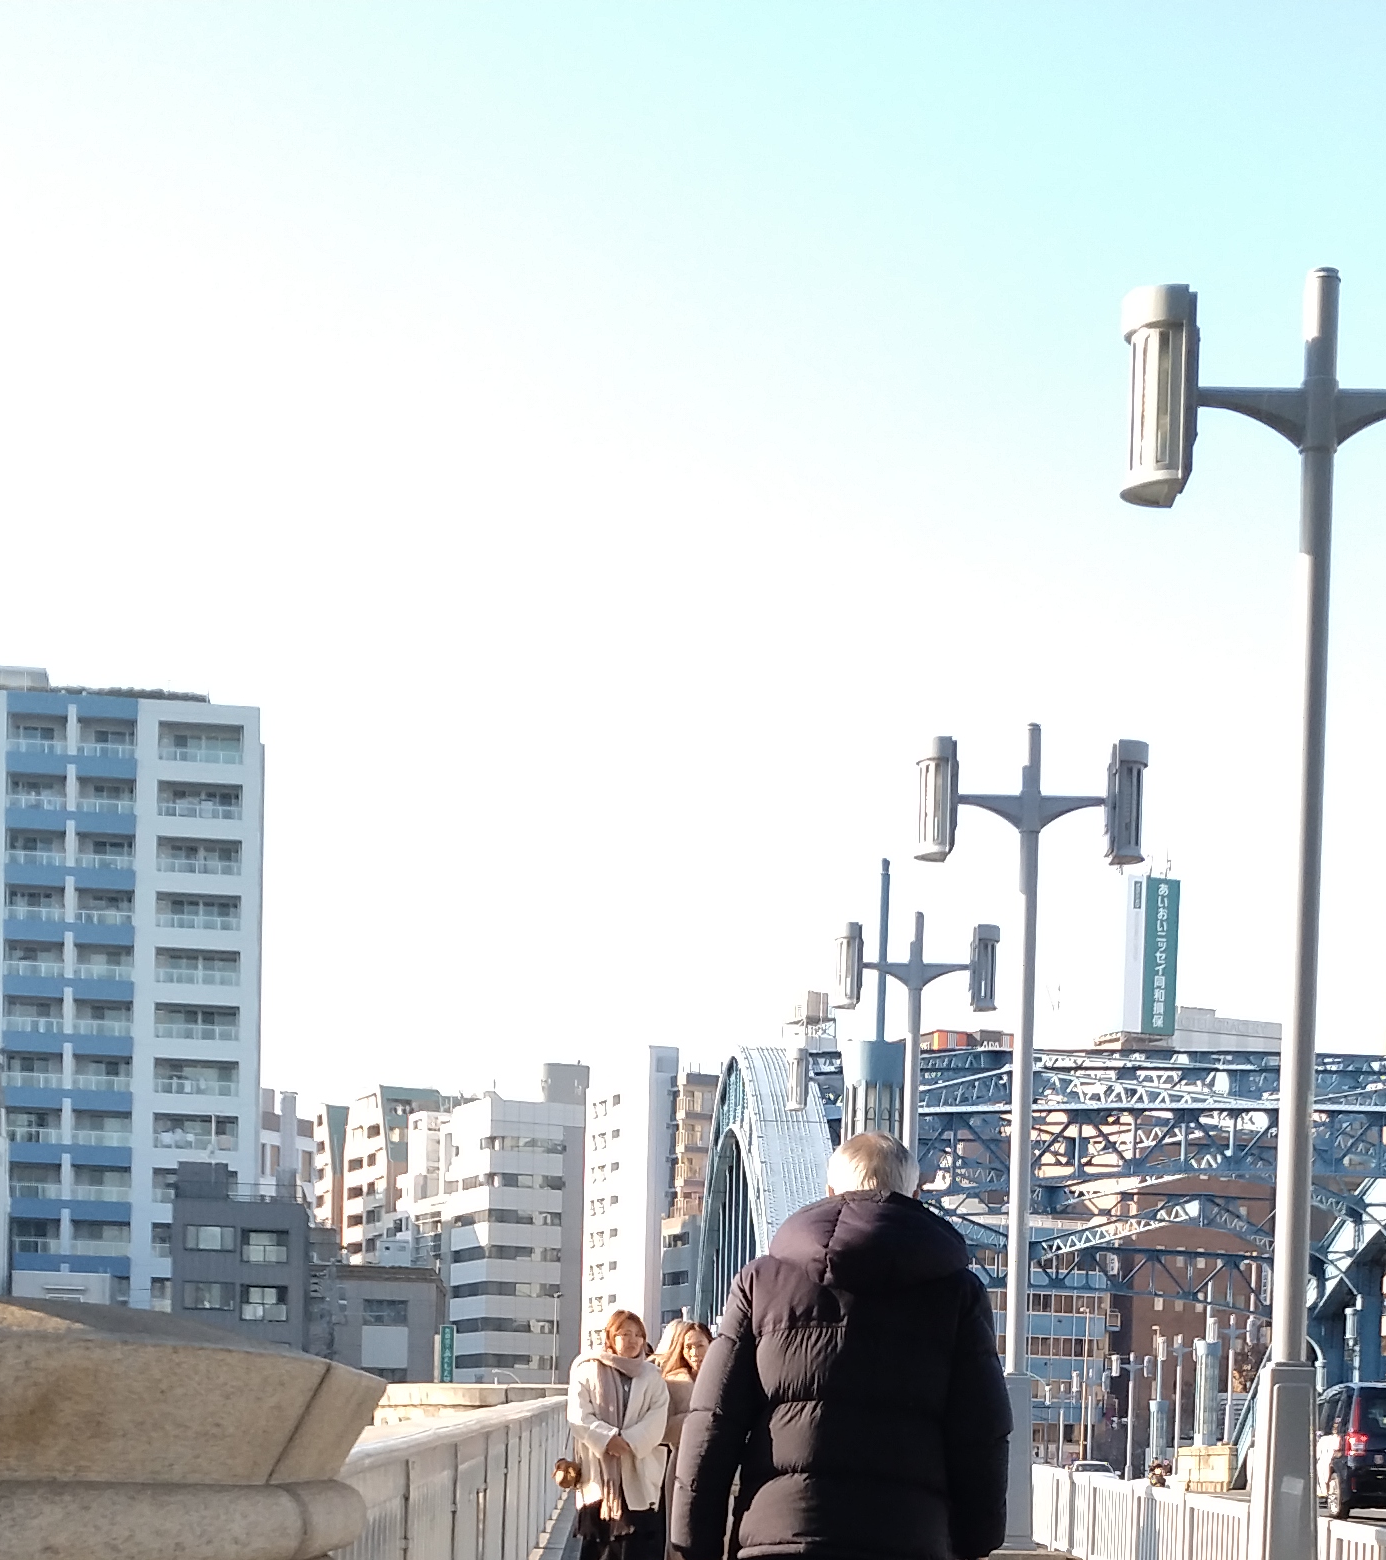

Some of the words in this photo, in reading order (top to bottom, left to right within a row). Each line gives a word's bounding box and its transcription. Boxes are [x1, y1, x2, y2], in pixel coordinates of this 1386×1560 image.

[1152, 883, 1169, 1028] あいおいニッセイ同和損保
